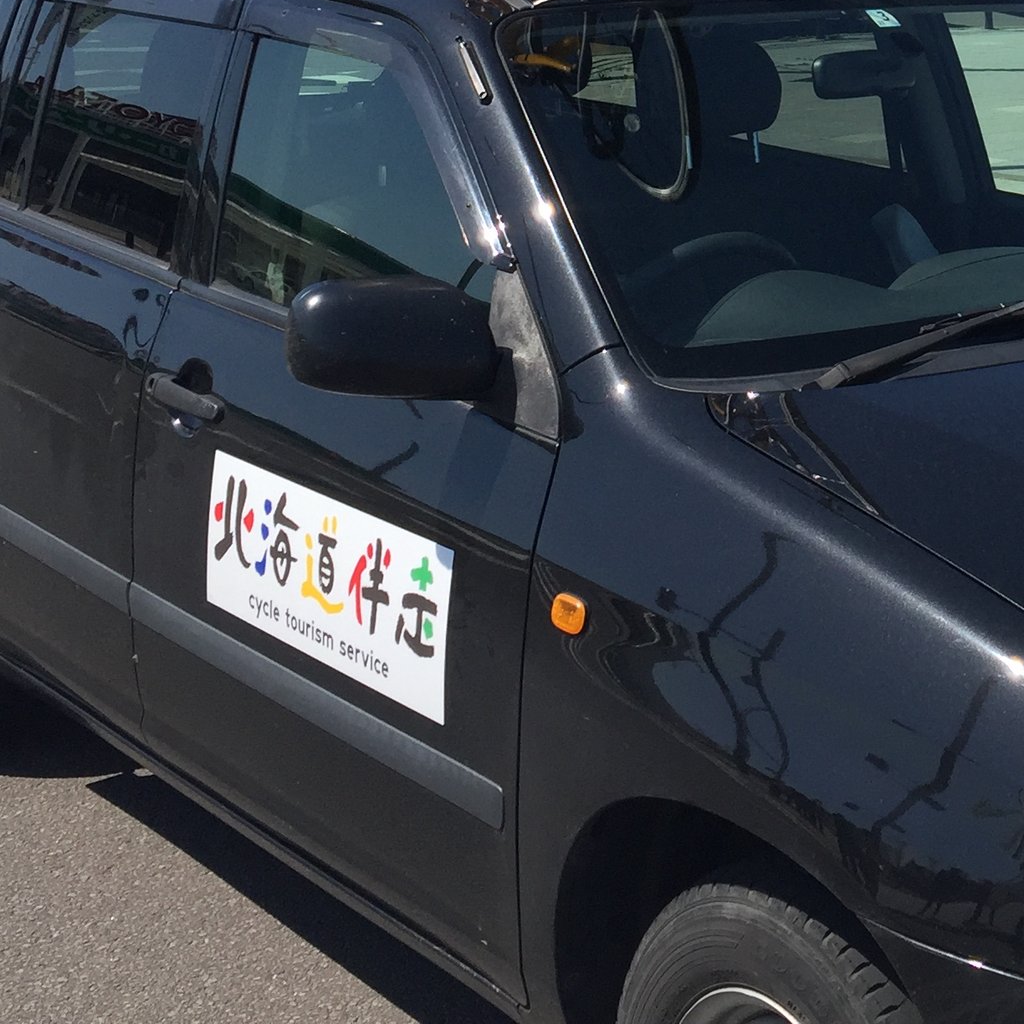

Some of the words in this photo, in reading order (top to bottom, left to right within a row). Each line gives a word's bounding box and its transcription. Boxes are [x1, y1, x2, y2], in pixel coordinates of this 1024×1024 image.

[248, 593, 280, 622] cycle
[285, 608, 334, 651] tourism
[339, 640, 389, 678] service
